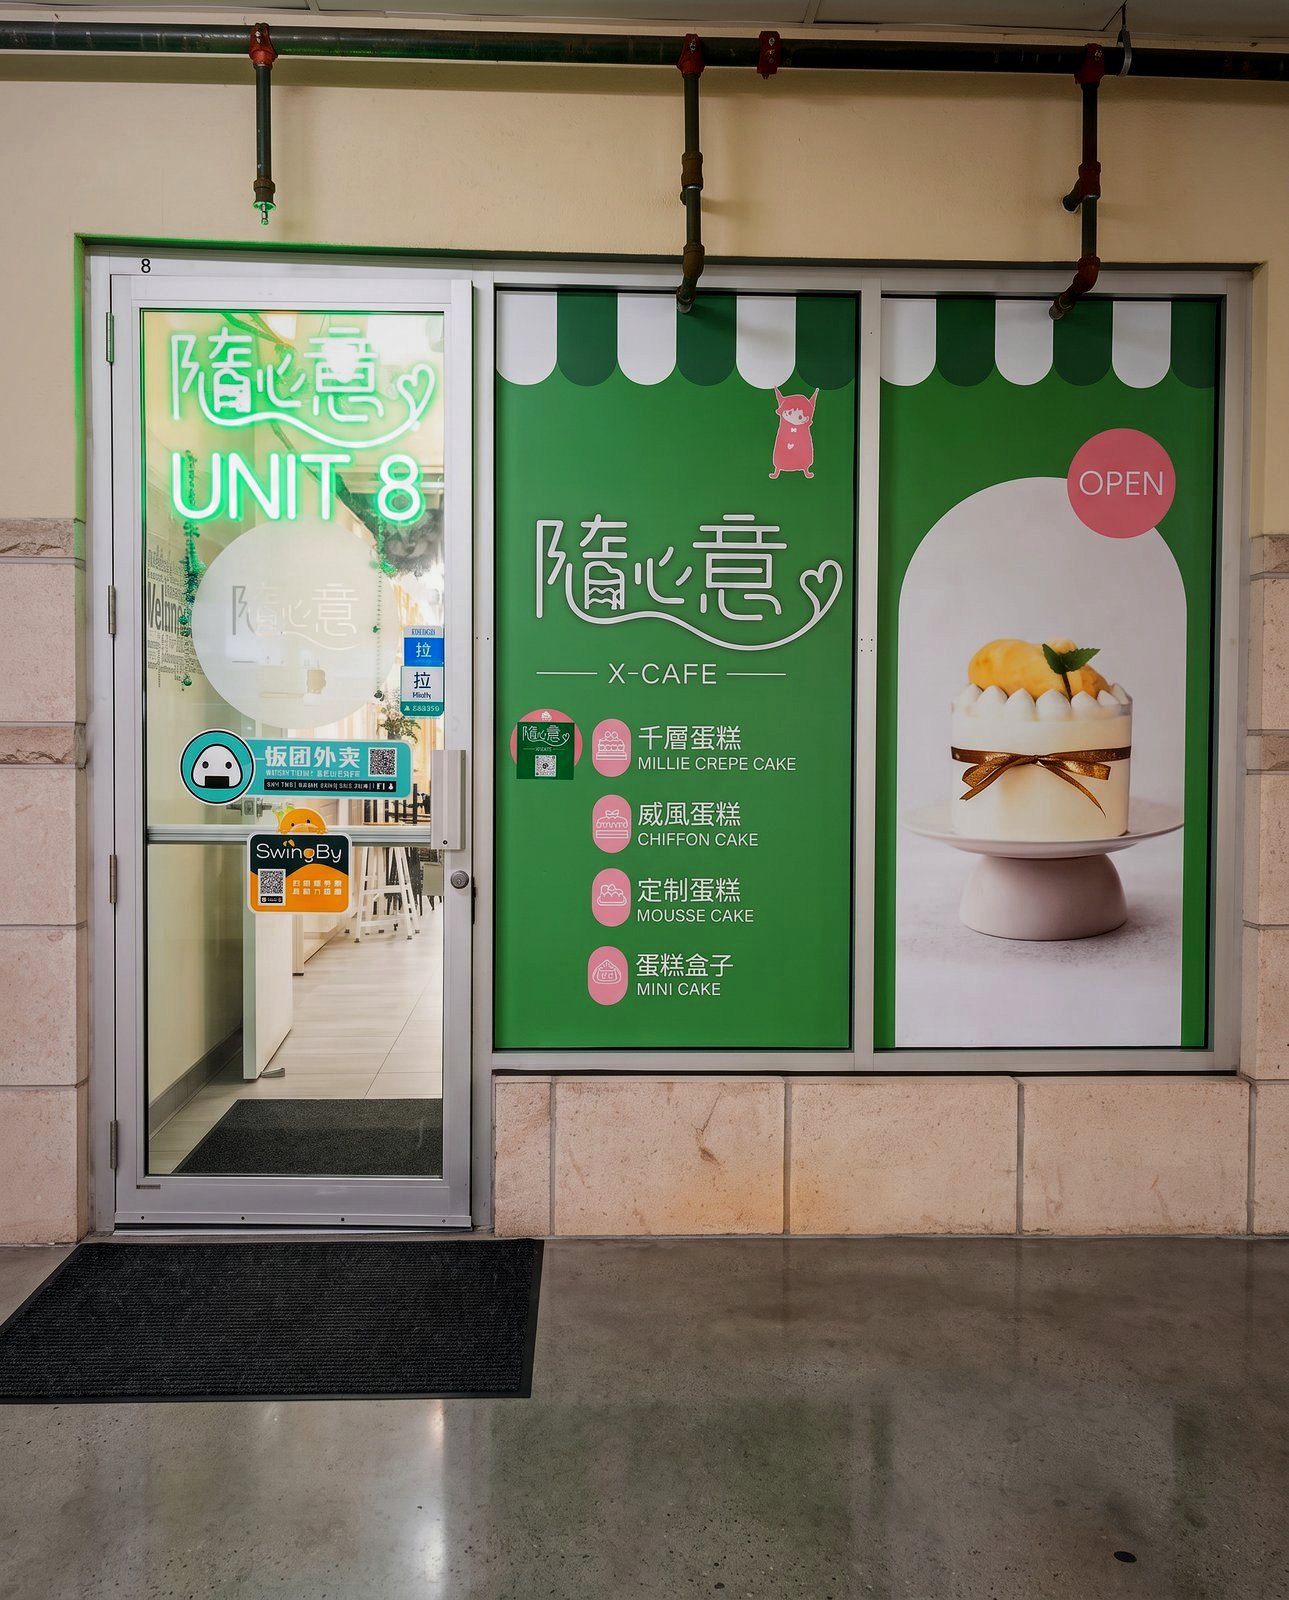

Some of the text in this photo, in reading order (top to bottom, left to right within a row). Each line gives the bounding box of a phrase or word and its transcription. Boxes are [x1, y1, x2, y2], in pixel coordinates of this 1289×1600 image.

[141, 258, 151, 273] 8
[171, 452, 422, 521] UNIT 8
[1080, 471, 1163, 495] OPEN
[608, 663, 717, 685] X-CAFE
[638, 725, 742, 751] 千層蛋糕
[638, 757, 796, 771] MILLIE CREPE CAKE
[638, 802, 741, 827] 威風蛋糕
[638, 833, 758, 846] CHIFFON CAKE
[256, 843, 341, 863] SwingBy
[638, 878, 740, 902] 定制蛋糕
[637, 909, 754, 922] MOUSSE CAKE
[636, 954, 734, 978] 蛋糕盒子
[637, 983, 721, 996] MINI CAKE
